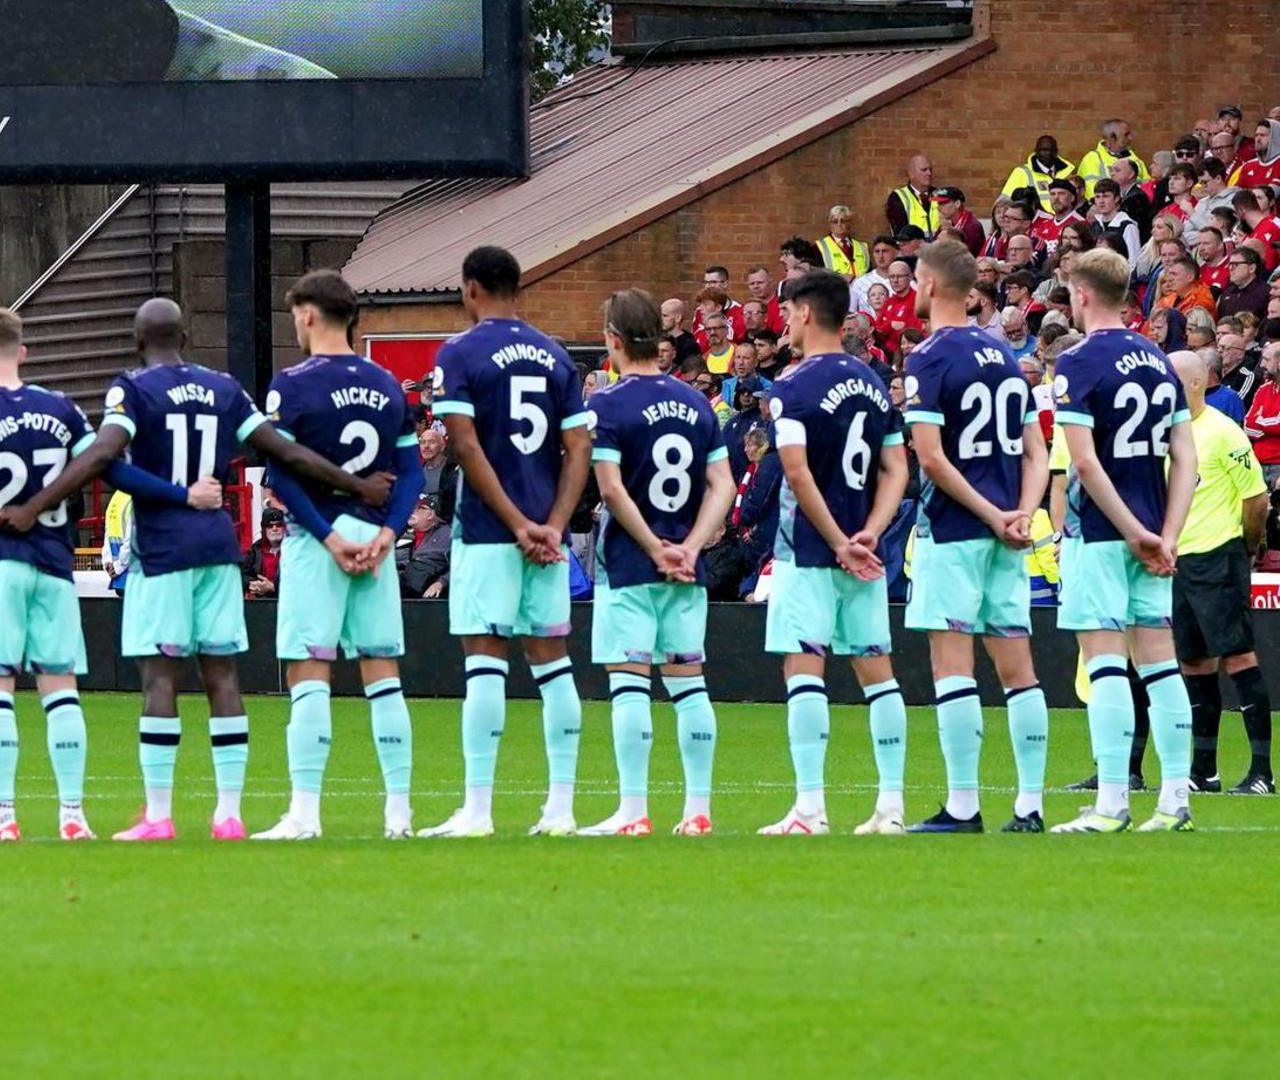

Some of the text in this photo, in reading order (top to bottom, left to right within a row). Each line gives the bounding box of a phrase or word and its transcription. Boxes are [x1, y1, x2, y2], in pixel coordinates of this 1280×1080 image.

[492, 343, 555, 371] PINNOCK
[974, 348, 1004, 367] AJER
[1115, 353, 1168, 375] COLLINS
[167, 383, 214, 406] WISSA
[331, 387, 389, 411] HICKEY
[510, 376, 548, 454] 5
[642, 400, 698, 426] JENSEN
[959, 377, 1029, 459] 20
[1113, 381, 1177, 458] 22
[165, 413, 218, 483] 11
[336, 420, 380, 497] 2
[649, 433, 693, 512] 8
[842, 411, 872, 490] 6
